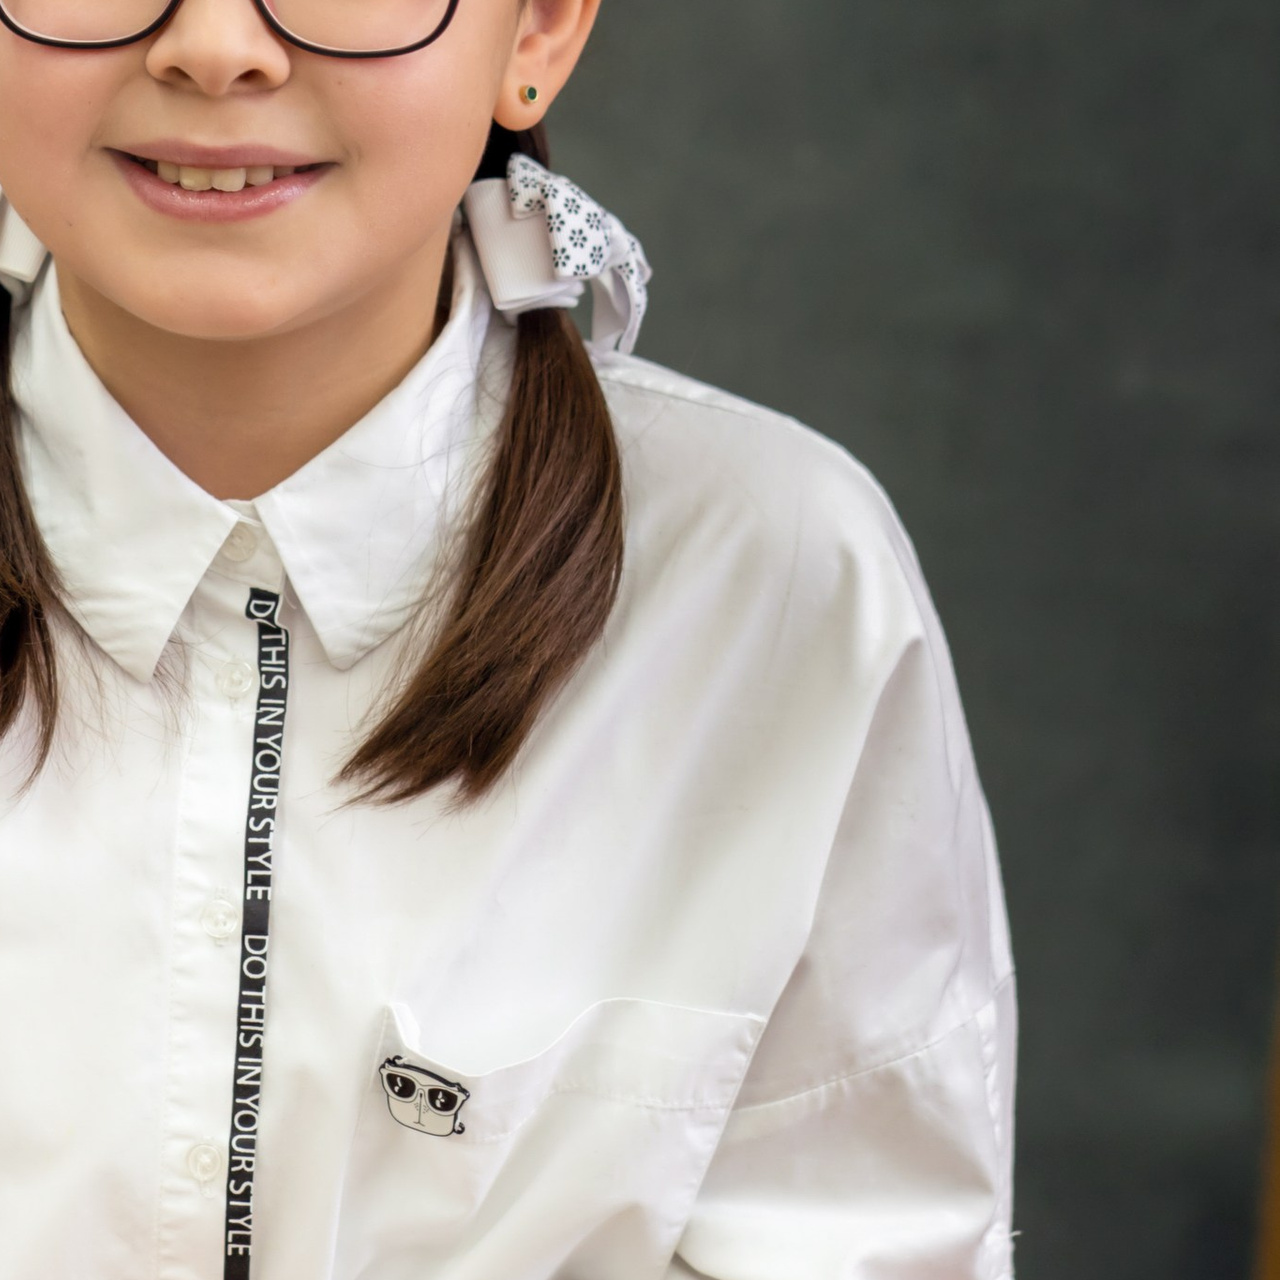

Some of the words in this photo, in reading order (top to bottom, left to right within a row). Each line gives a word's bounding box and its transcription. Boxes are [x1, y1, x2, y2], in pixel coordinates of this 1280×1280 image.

[260, 630, 287, 690] THIS
[257, 698, 285, 726] IN
[250, 732, 282, 810] YOUR
[245, 816, 275, 901] STYLE
[242, 933, 269, 979] DO
[239, 984, 266, 1048] THIS
[235, 1056, 263, 1085] IN
[230, 1093, 260, 1173] YOUR
[226, 1179, 254, 1257] STYLE
